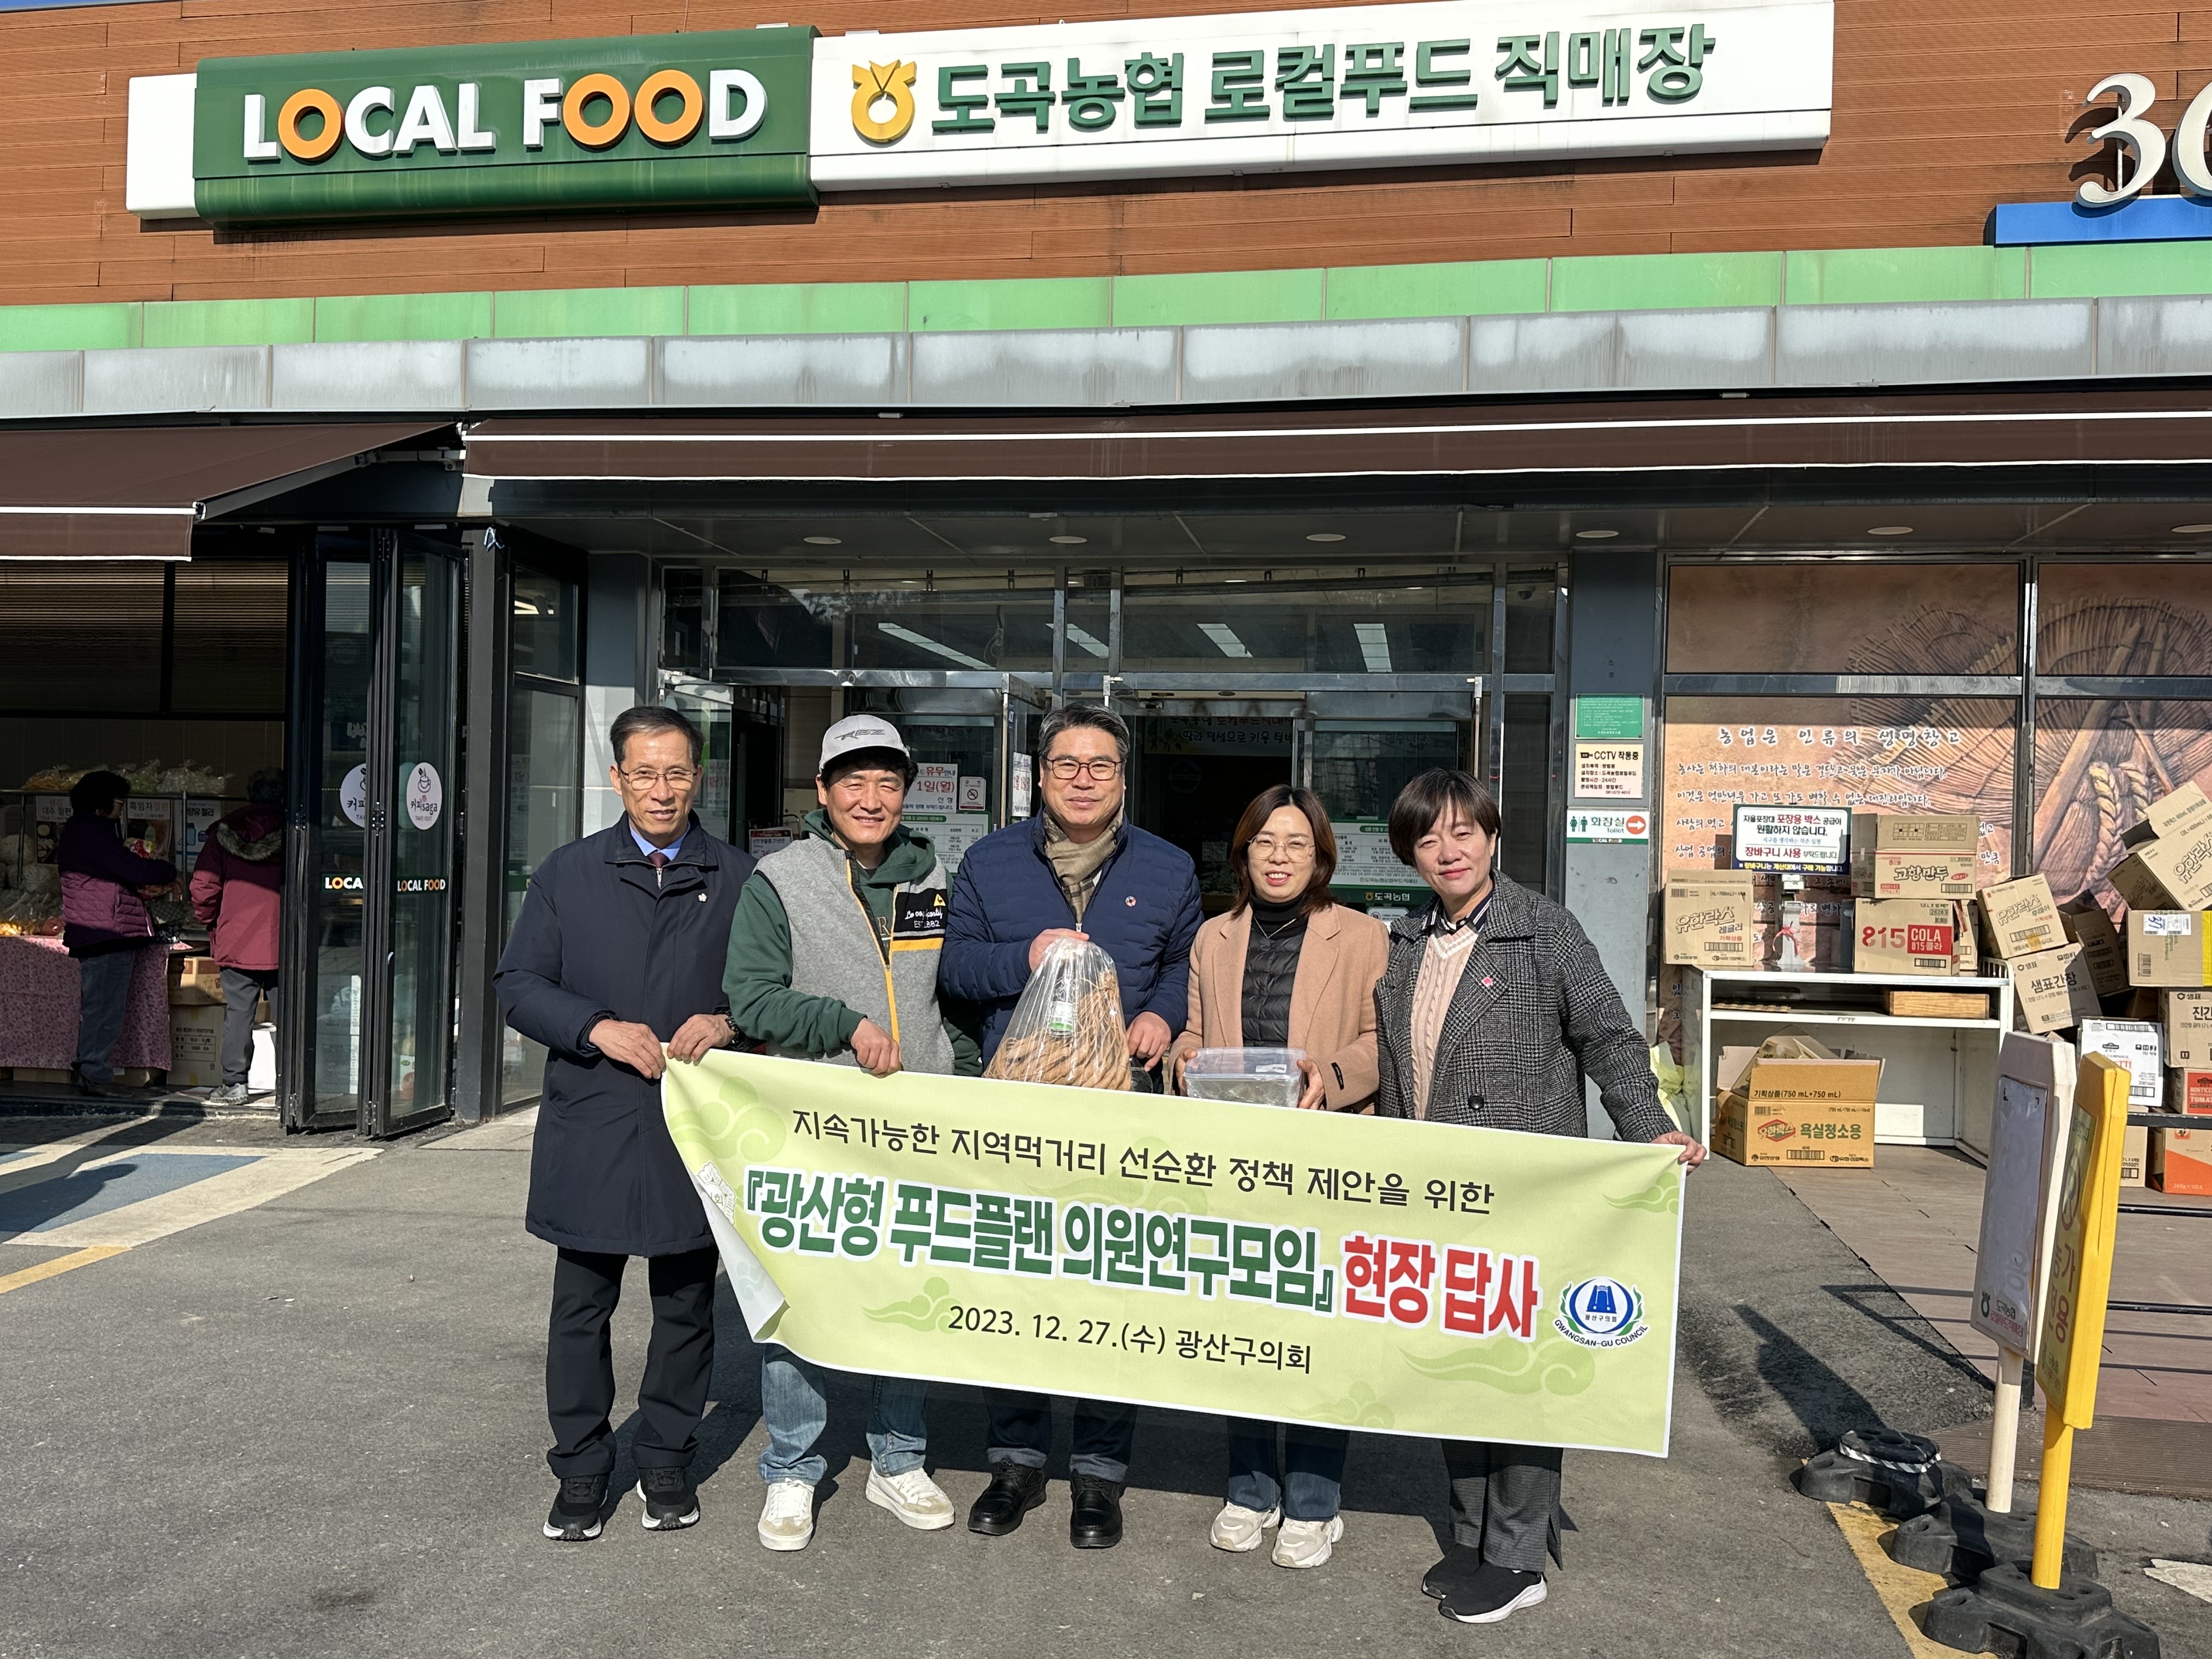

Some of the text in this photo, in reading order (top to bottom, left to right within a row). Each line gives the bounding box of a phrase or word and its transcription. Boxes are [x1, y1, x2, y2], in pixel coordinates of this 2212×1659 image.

[931, 22, 1716, 133] 도곡농협 로컬푸드 직매장
[242, 68, 768, 163] LOCAL FOOD
[1720, 729, 1960, 747] 농업은 인류의 생명창고
[1594, 751, 1639, 760] CCTV 작동중
[1678, 763, 1705, 775] 농사는
[917, 781, 955, 793] 1일(월)
[1677, 791, 1704, 803] 이것은
[1750, 792, 1767, 803] 가고
[1832, 795, 1841, 804] 수
[129, 801, 153, 811] 흑임자
[1591, 816, 1625, 827] 화장실
[1677, 817, 1703, 831] 사람의
[1707, 818, 1725, 830] 먹고
[1743, 815, 1775, 823] 자율포장대
[1777, 814, 1802, 824] 포장용
[1804, 814, 1821, 825] 박스
[1757, 825, 1790, 835] 원활하지
[1745, 847, 1780, 857] 장바구니
[1783, 848, 1801, 858] 사용
[1894, 865, 1949, 881] 고향만두
[397, 878, 446, 892] LOCAL FOOD
[1374, 893, 1410, 901] 도곡농협
[1996, 894, 2042, 927] 유한락스
[1675, 906, 1735, 934] 유한락스
[1719, 923, 1743, 934] 레귤러
[1911, 928, 1942, 943] COLA
[1862, 926, 1906, 949] 815
[1911, 941, 1943, 951] 815콜라
[2025, 961, 2038, 970] 샘표
[2030, 971, 2077, 994] 샘표간장
[1754, 1090, 1841, 1098] 기획상품(750 mL+750 mL)
[1758, 1122, 1795, 1139] 유한락스
[1800, 1123, 1861, 1140] 욕실청소용
[793, 1110, 1496, 1215] 지속가능한 지역먹거리 선순환 정책 제안을 위한
[747, 1170, 1538, 1338] 『광산형 푸드플랜 의원연구모임』 현장 답사
[1996, 1300, 2016, 1320] 도곡농협
[1584, 1314, 1617, 1323] 광산구의회
[1990, 1308, 2023, 1338] 로컬푸드직매장
[948, 1305, 1312, 1375] 2023. 12. 27.(수) 광산구의회
[1554, 1319, 1649, 1347] GWANGSAN-GU COUNCIL
